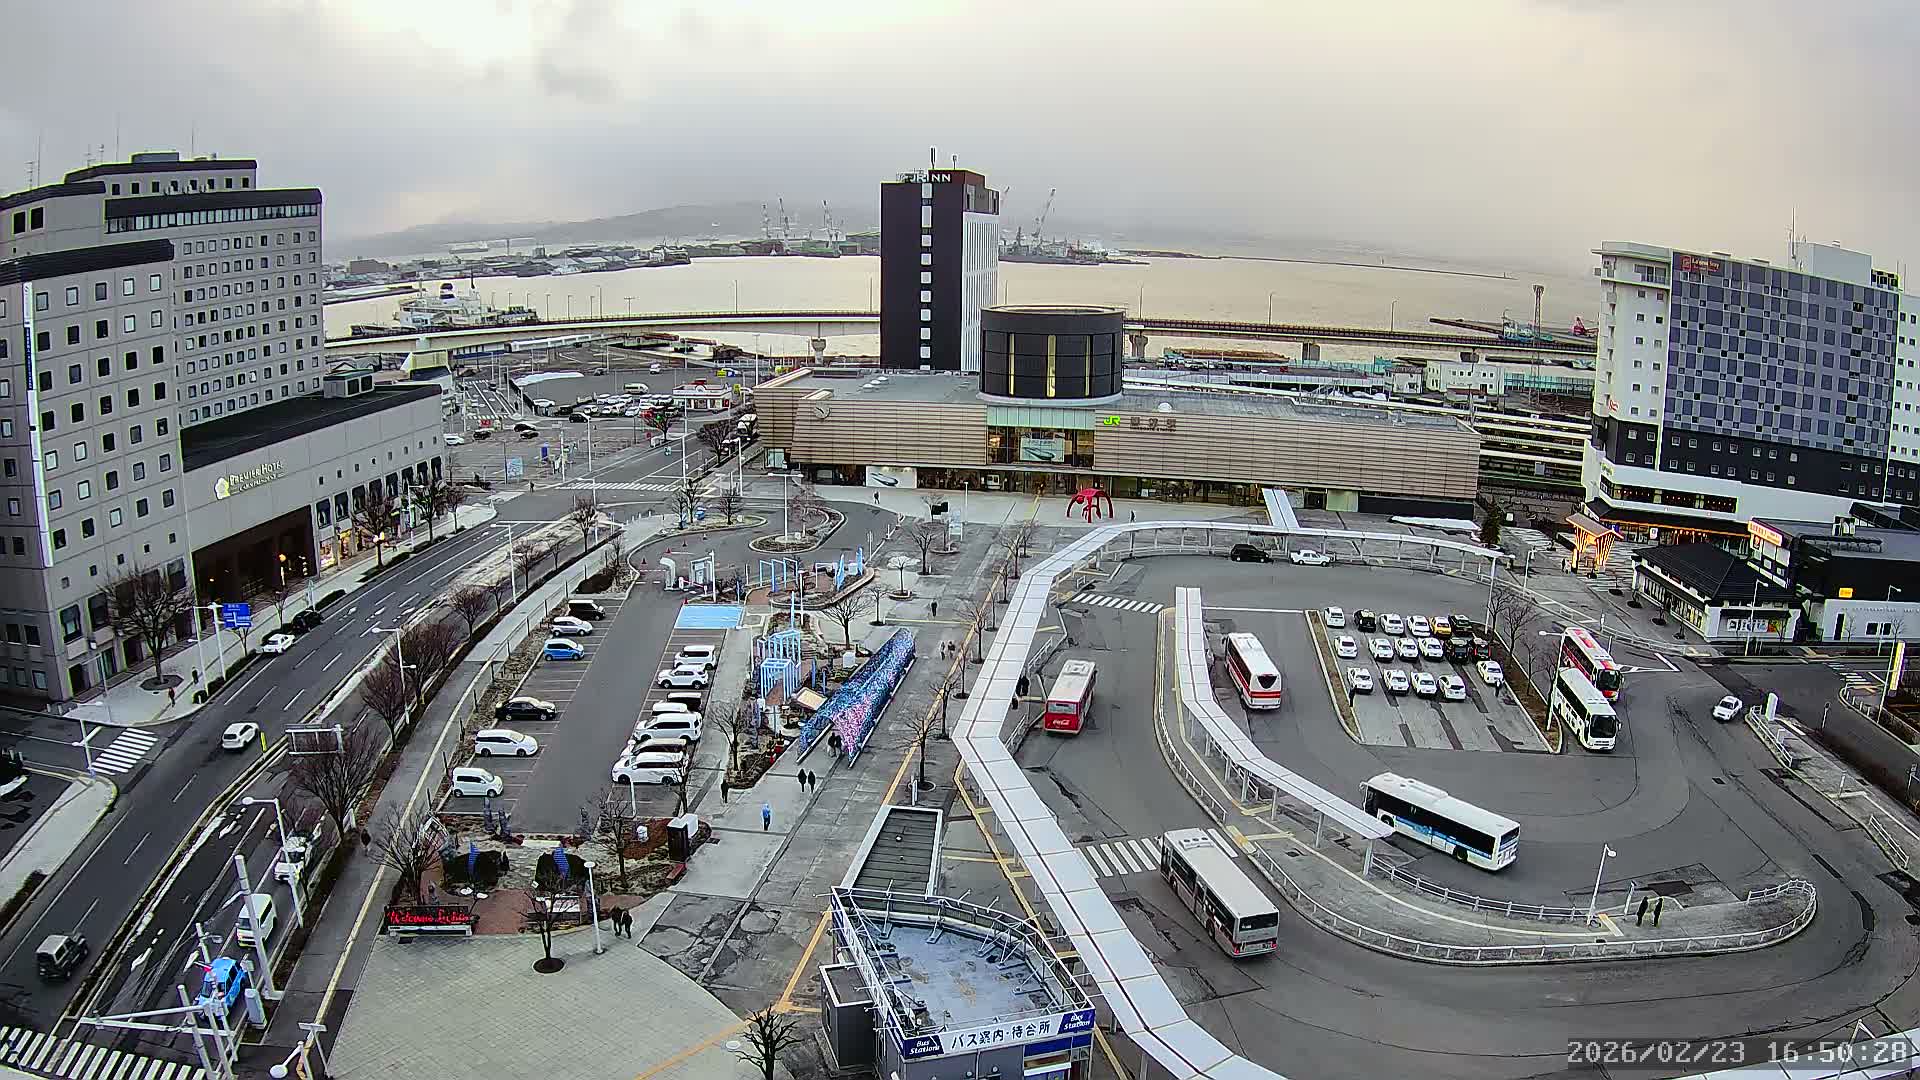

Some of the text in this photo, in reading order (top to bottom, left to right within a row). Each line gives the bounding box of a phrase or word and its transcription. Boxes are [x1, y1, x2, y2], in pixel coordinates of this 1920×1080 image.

[927, 173, 951, 182] INN
[1103, 415, 1121, 426] JR
[1070, 1013, 1084, 1022] Bus
[1063, 1019, 1091, 1031] Station
[951, 1019, 1051, 1050] バス案内・待合所
[909, 1045, 940, 1055] Station
